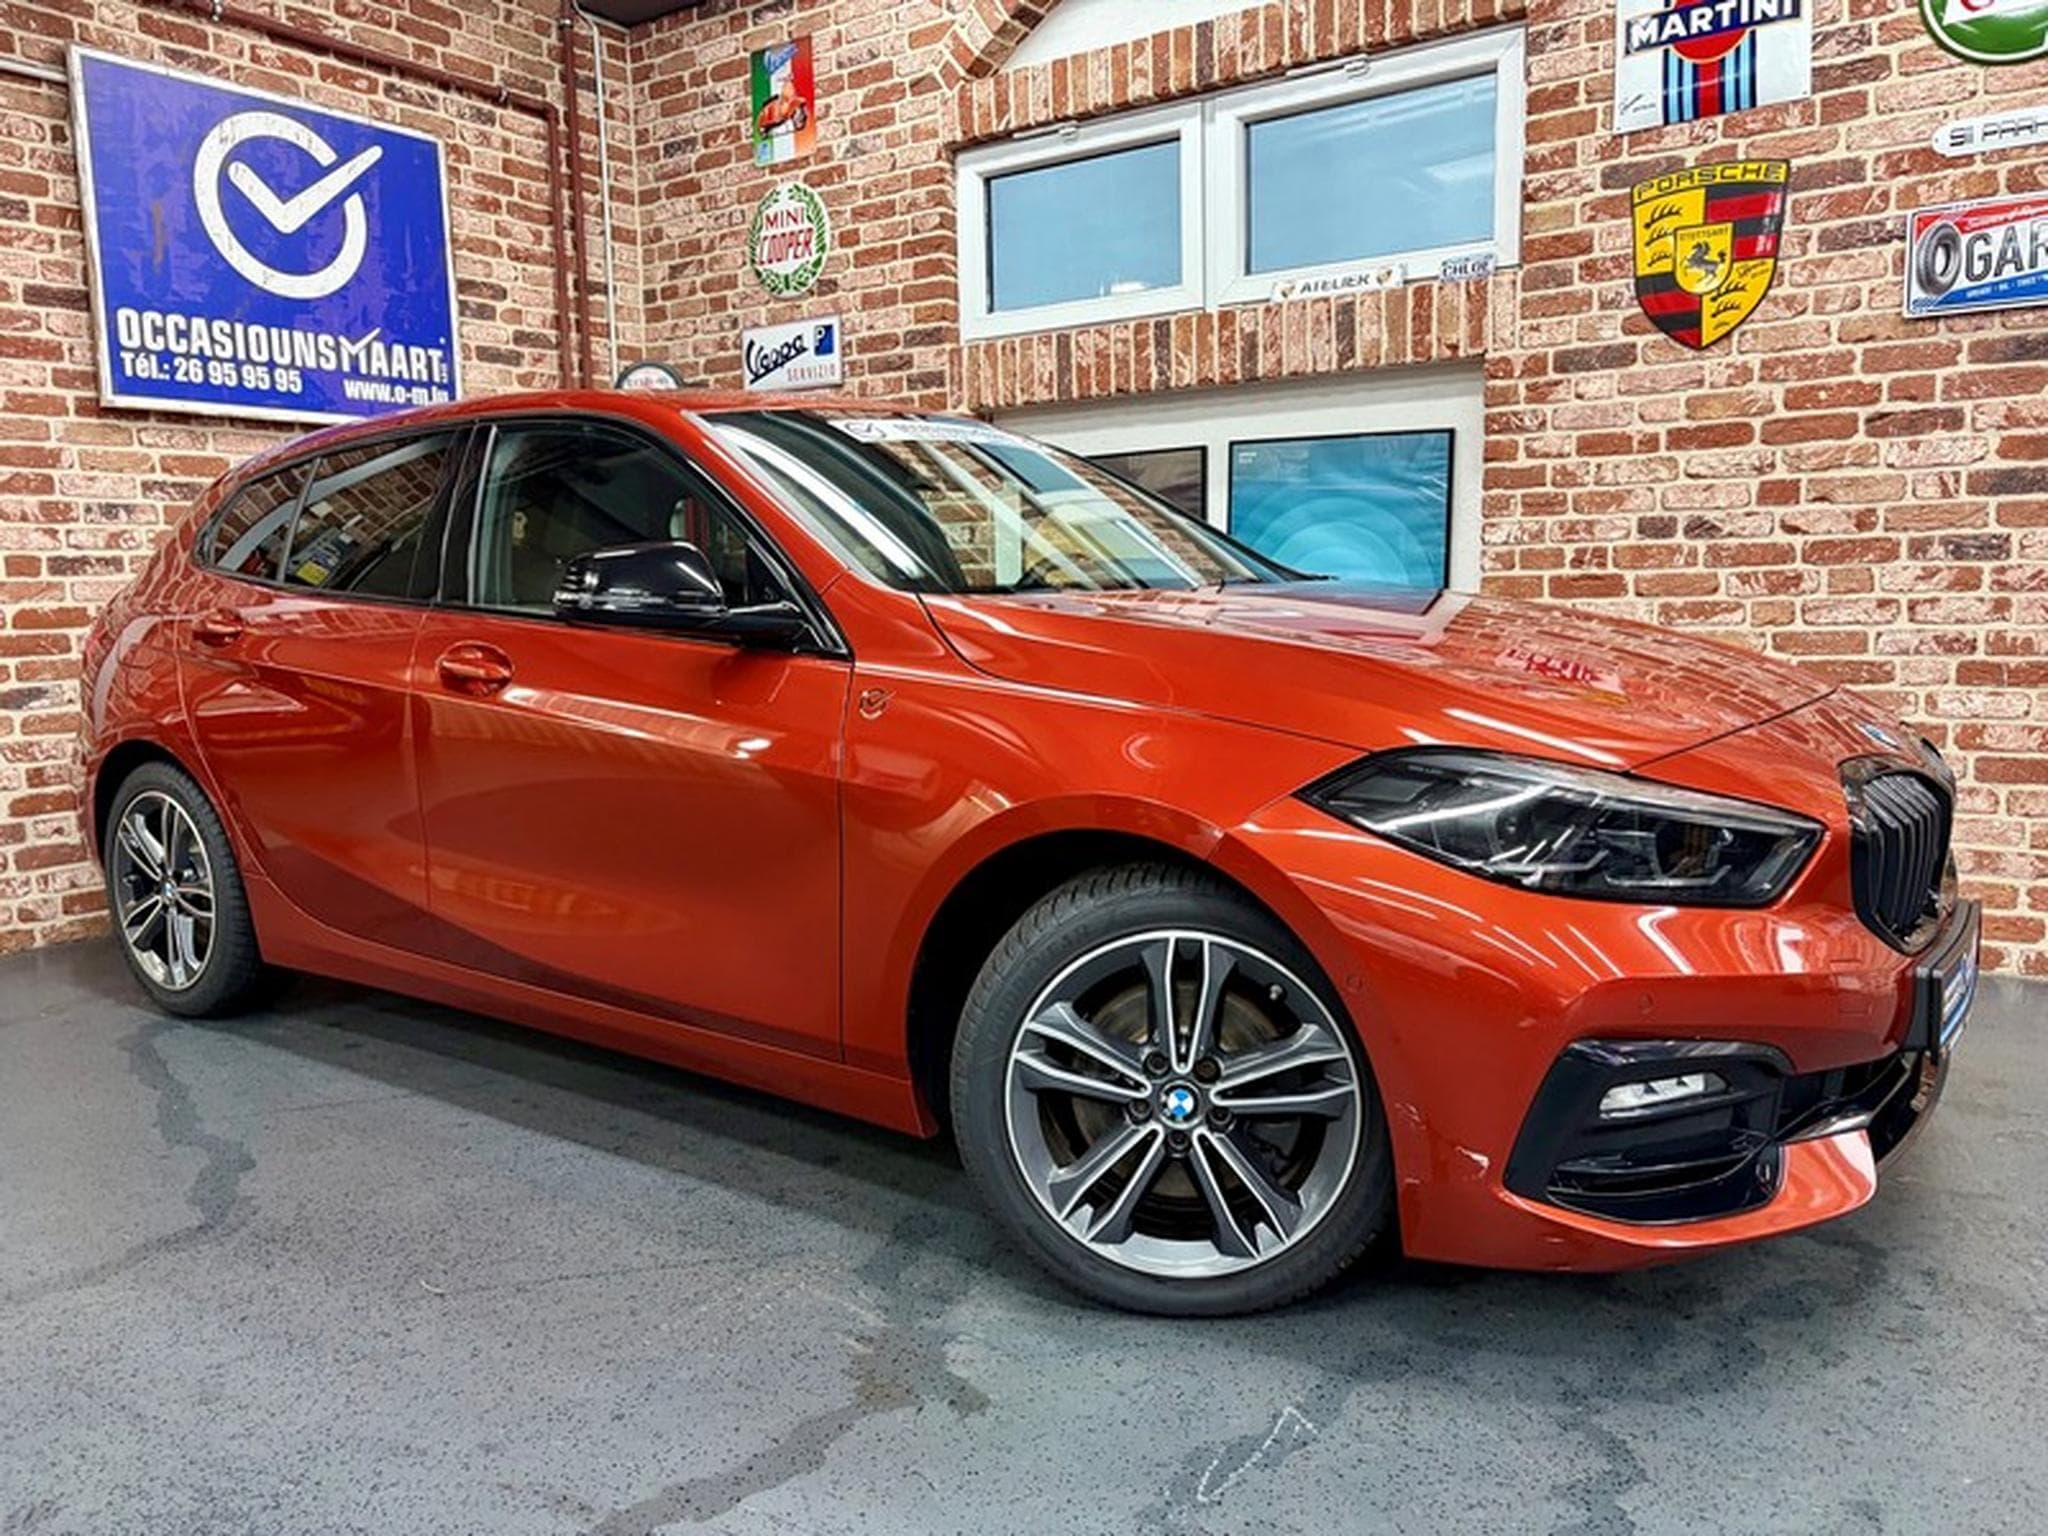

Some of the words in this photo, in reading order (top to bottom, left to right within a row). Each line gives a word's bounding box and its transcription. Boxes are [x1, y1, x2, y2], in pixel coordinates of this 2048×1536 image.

[1630, 0, 1793, 50] MARTINI
[1636, 163, 1783, 199] PORSCHE
[765, 206, 805, 231] MINI
[759, 227, 814, 266] COOPER
[1300, 274, 1371, 294] ATELIER
[116, 306, 444, 384] OCCASIOUNSMAART
[745, 337, 808, 385] Vespa
[120, 351, 171, 381] Tél.:
[173, 356, 204, 385] 26
[207, 360, 239, 388] 95
[242, 363, 272, 391] 95
[274, 367, 304, 395] 95
[787, 363, 836, 382] SERVIZIO
